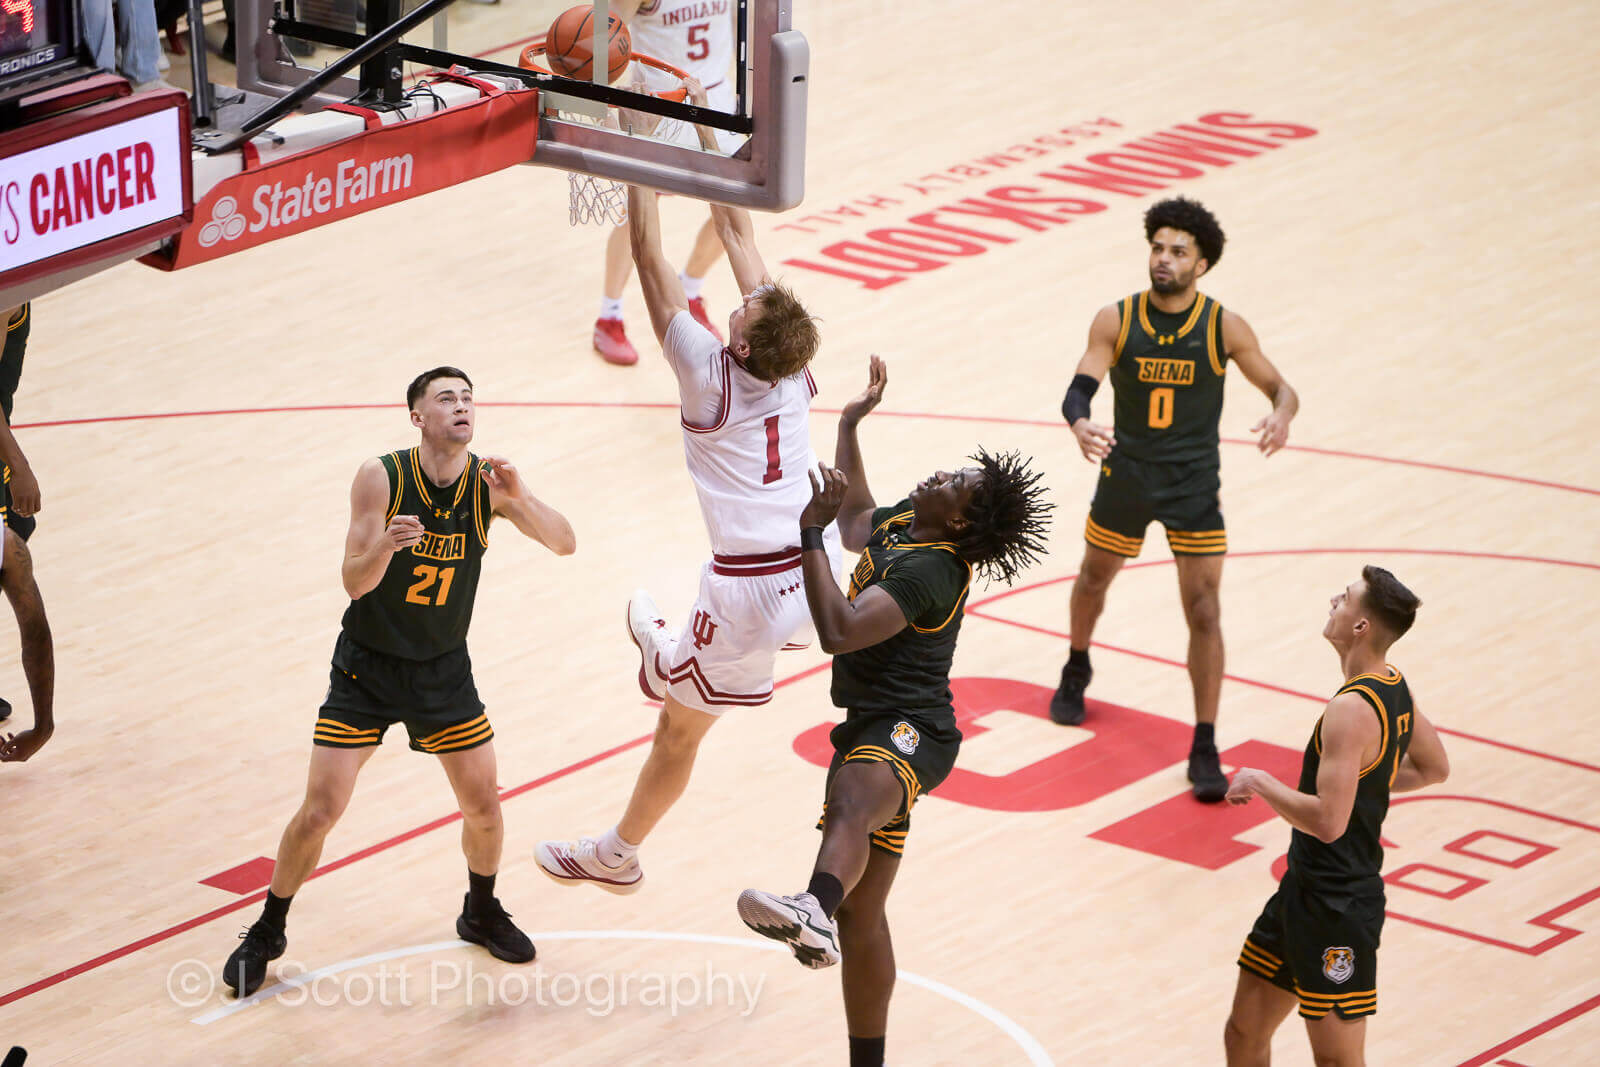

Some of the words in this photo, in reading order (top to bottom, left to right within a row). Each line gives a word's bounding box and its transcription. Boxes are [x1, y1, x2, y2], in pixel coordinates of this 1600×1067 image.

[687, 23, 709, 62] 5
[904, 116, 1124, 195] ASSEMBLY
[1037, 111, 1318, 198] SIMON
[0, 181, 20, 245] S
[30, 141, 157, 236] CANCER
[771, 193, 903, 233] HALL
[781, 185, 1108, 290] SKJODT
[1139, 359, 1194, 384] SIENA
[1148, 387, 1175, 429] 0
[763, 414, 783, 485] 1
[413, 531, 465, 559] SIENA
[405, 563, 456, 606] 21
